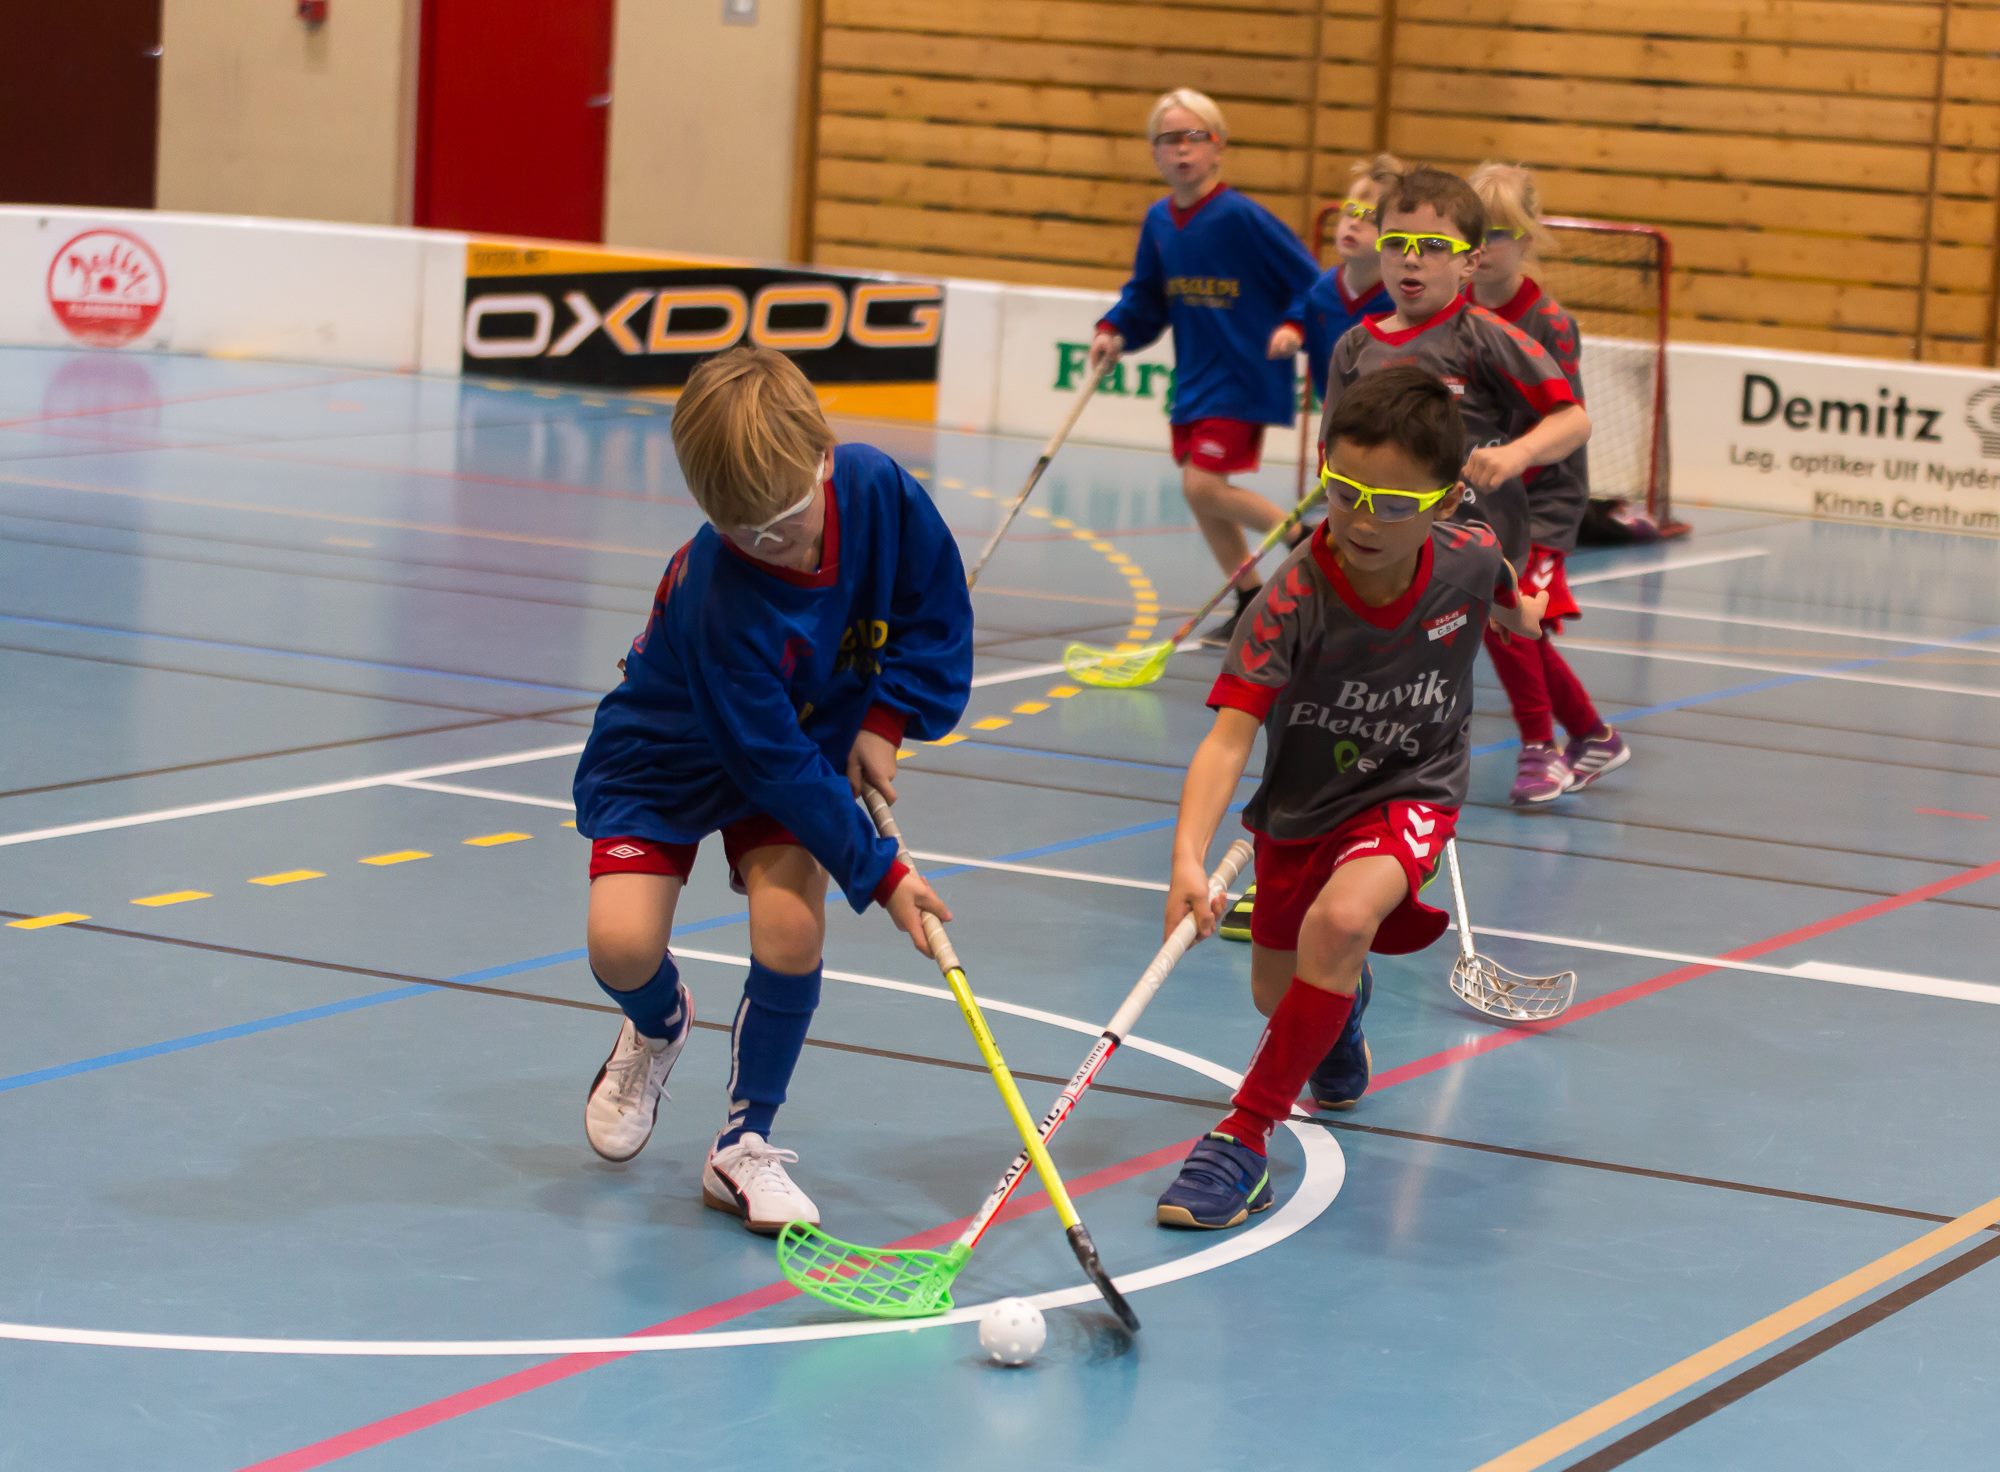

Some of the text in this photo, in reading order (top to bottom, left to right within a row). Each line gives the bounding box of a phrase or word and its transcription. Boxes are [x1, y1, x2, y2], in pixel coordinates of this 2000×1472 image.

[463, 283, 943, 359] OXDOG
[1741, 373, 1943, 444] Demitz
[1729, 444, 1781, 474] Leg.
[1789, 454, 1875, 477] optiker
[1883, 459, 1918, 482] Ulf
[1813, 491, 2000, 528] Kinna Centrum
[1335, 669, 1450, 713] Buvik
